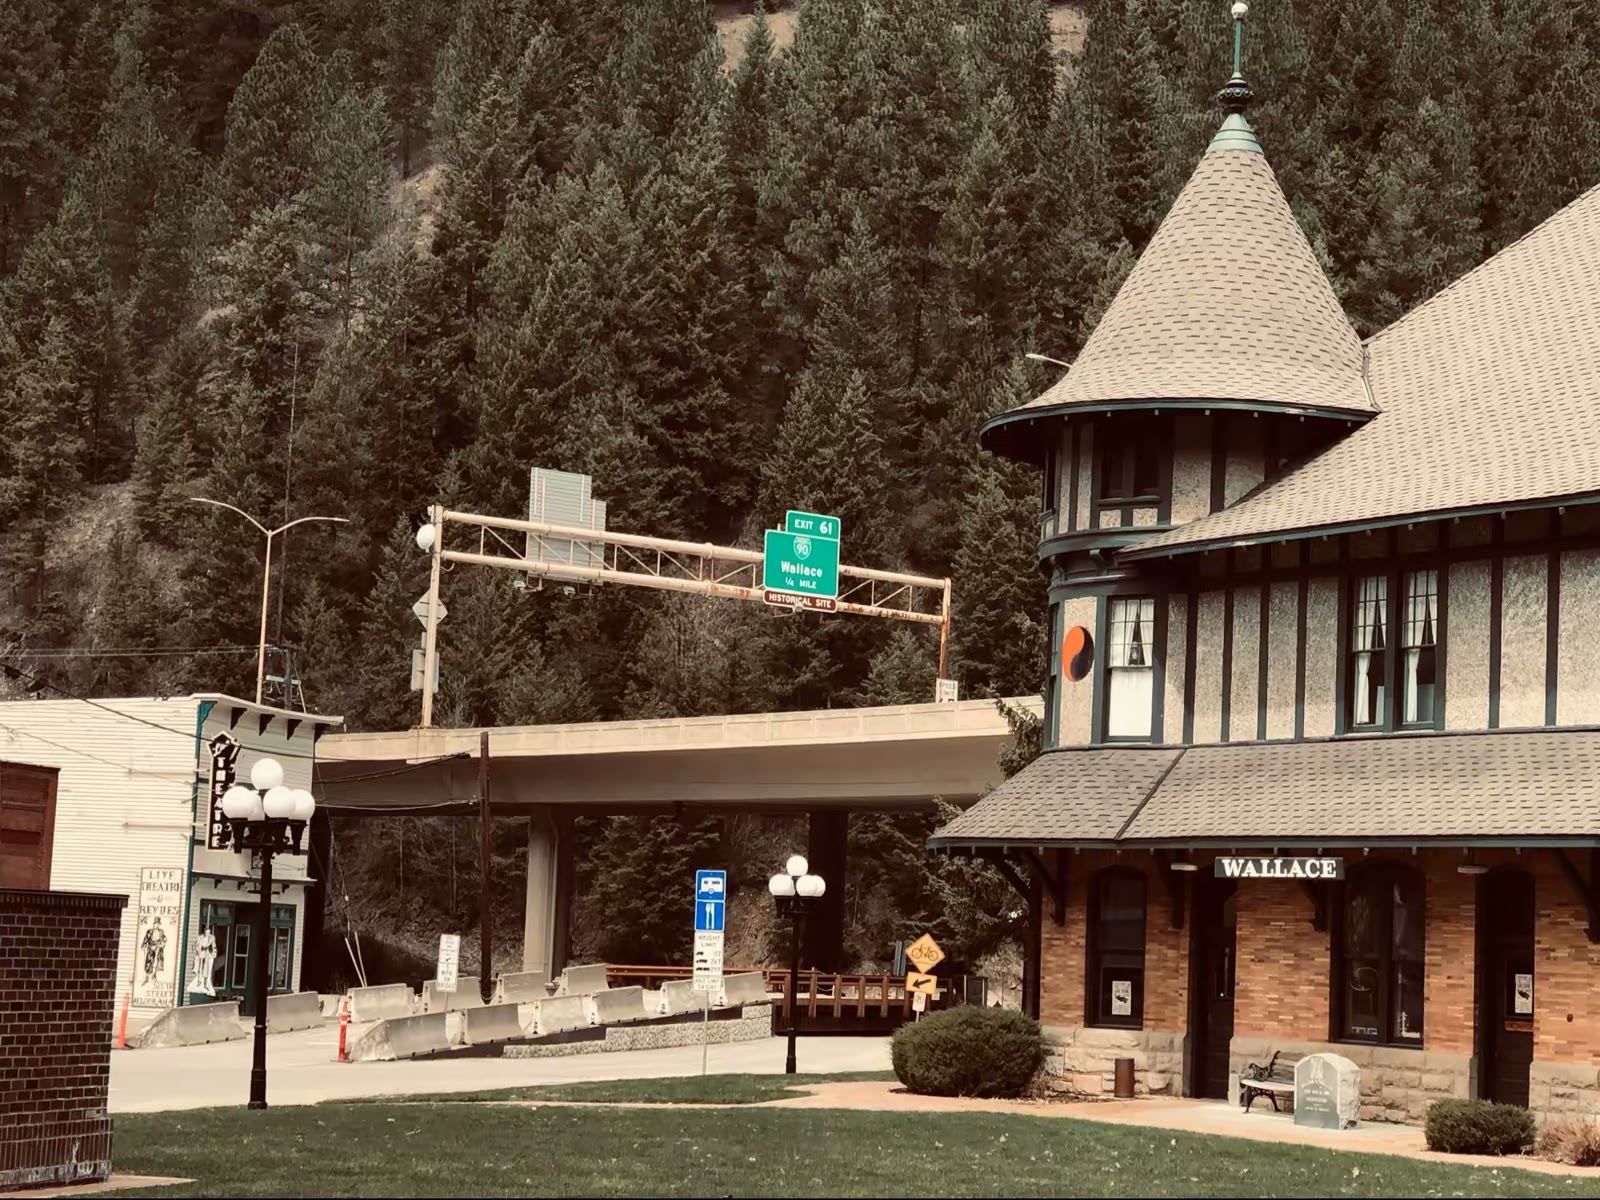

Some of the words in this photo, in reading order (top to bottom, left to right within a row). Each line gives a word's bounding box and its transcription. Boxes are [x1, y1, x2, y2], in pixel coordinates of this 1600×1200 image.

[794, 519, 814, 530] EXIT
[819, 521, 833, 535] 61
[796, 544, 809, 555] 90
[781, 561, 823, 577] Wallace
[799, 580, 817, 589] MILE
[769, 593, 812, 606] HISTORICAL
[815, 599, 832, 608] SITE
[939, 681, 957, 690] SPEED
[211, 757, 226, 846] THEATRE
[148, 870, 176, 880] LIVE
[1221, 859, 1337, 878] WALLACE
[140, 905, 180, 915] REVUES
